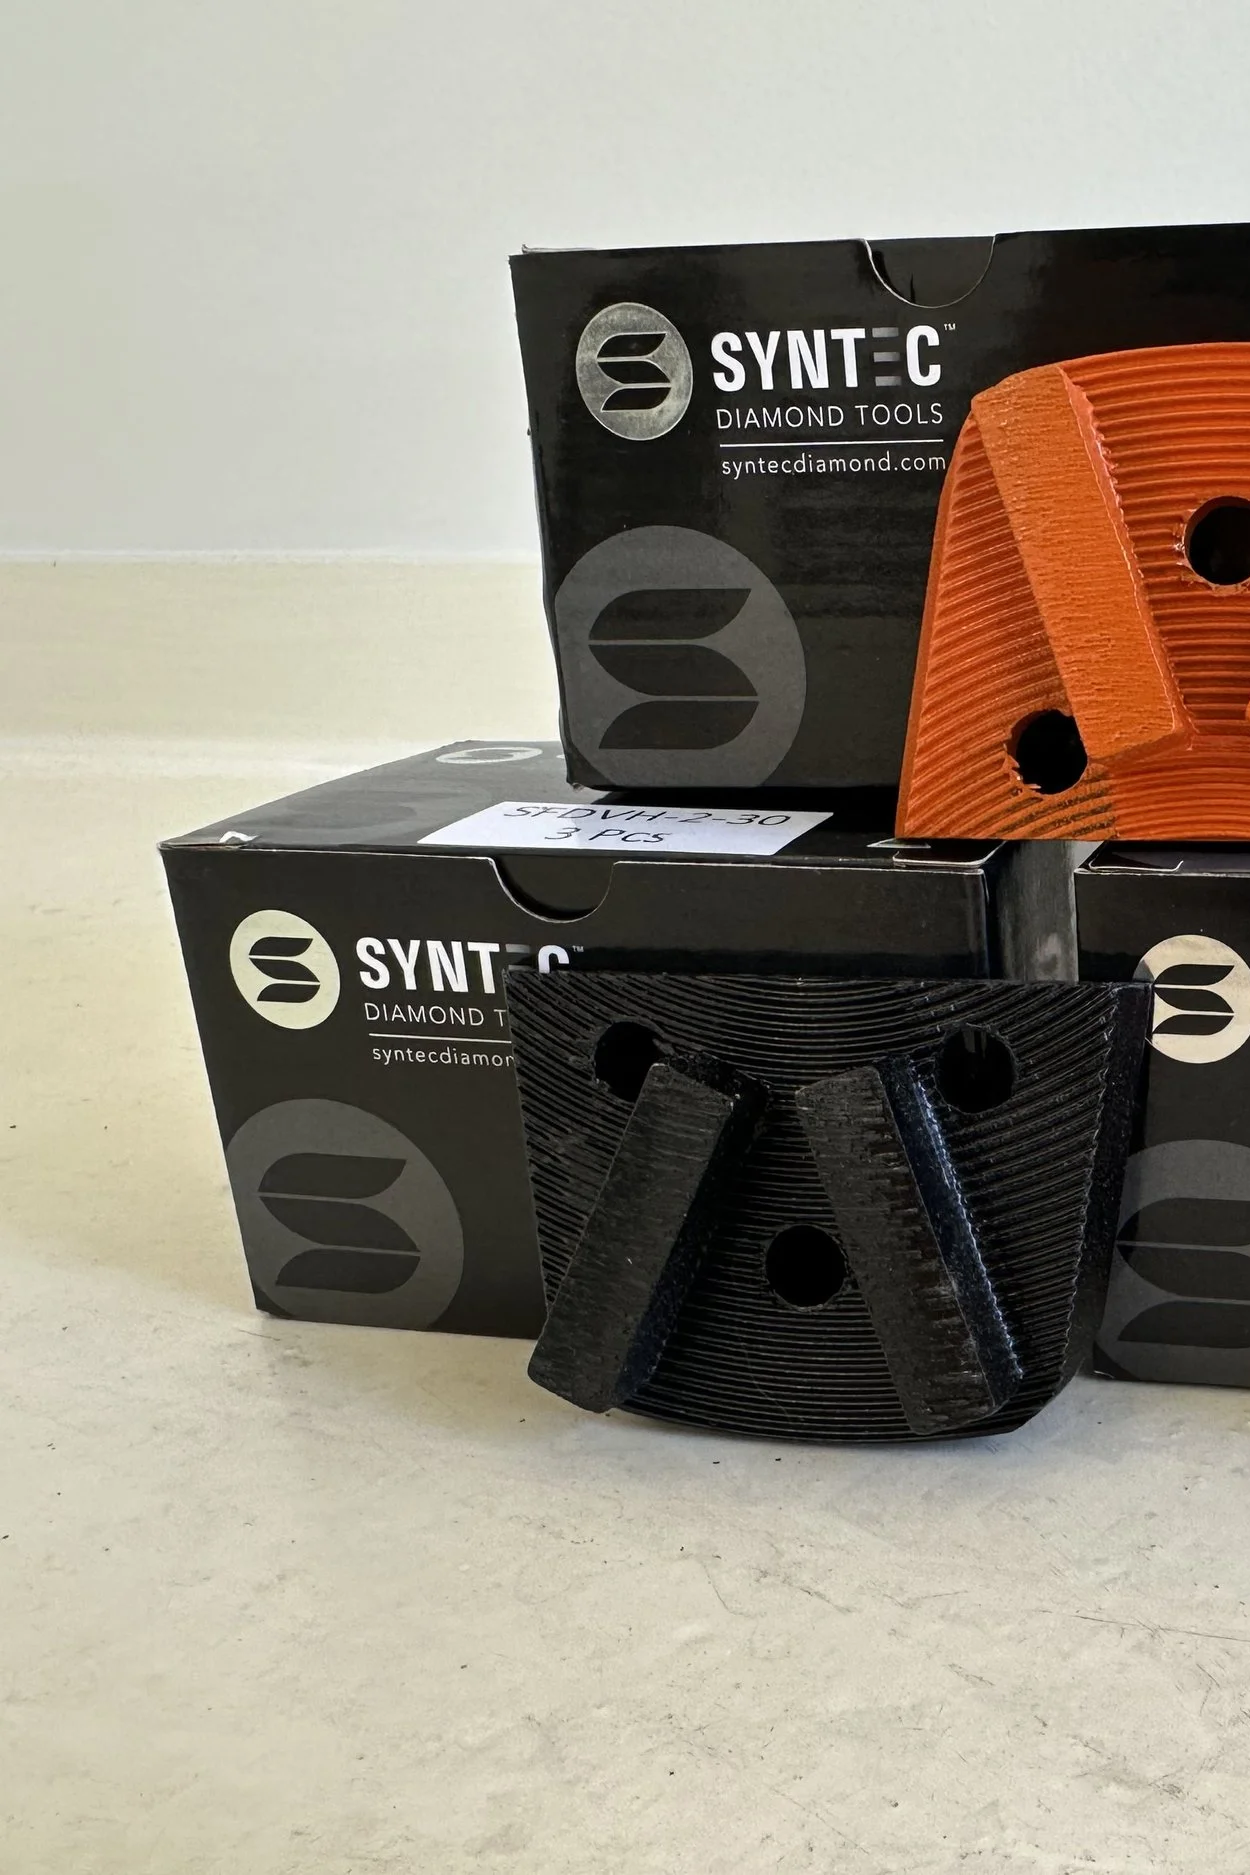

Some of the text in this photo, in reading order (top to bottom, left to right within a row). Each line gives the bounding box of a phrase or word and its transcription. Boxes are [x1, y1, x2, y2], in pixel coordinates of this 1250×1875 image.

[710, 325, 941, 392] SYNTEC
[716, 402, 944, 429] DIAMOND TOOLS
[721, 450, 946, 479] syntecdiamond.com
[503, 806, 792, 826] SFDVH-2-30
[544, 827, 577, 841] 3
[364, 1002, 484, 1027] DIAMOND
